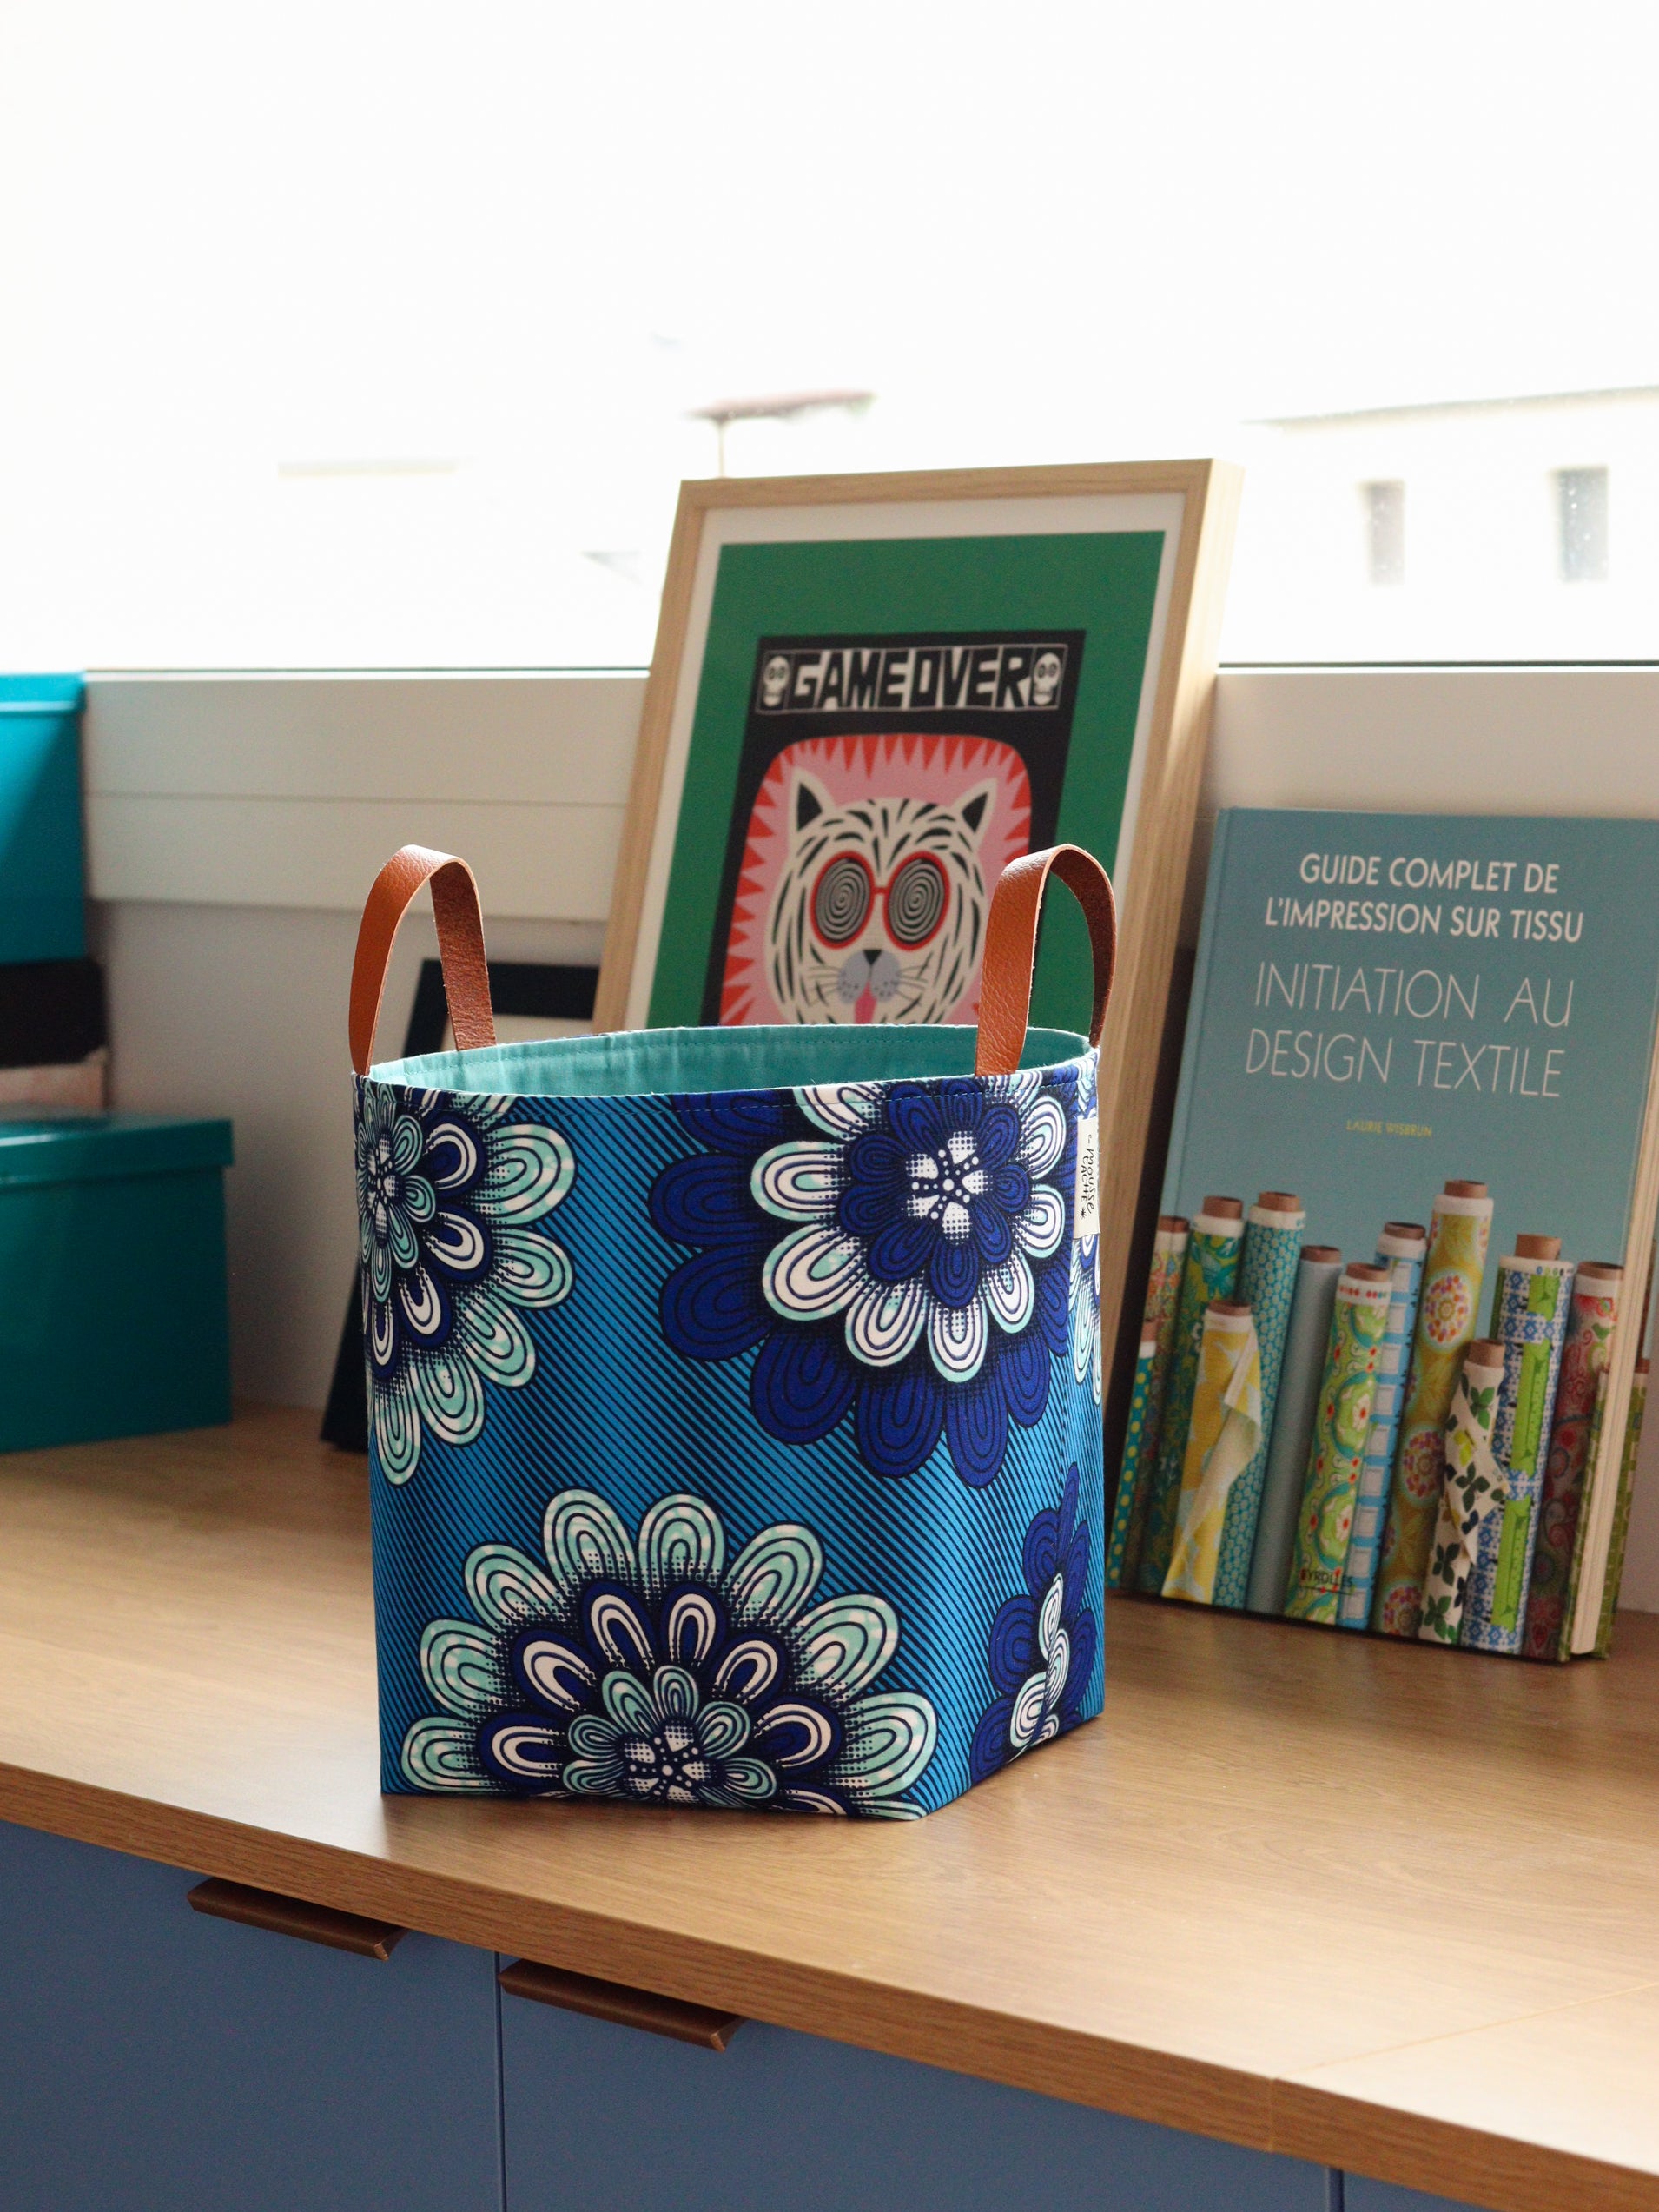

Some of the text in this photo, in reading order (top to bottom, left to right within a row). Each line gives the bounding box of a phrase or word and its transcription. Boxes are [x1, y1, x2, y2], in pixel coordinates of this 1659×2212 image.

[1299, 852, 1561, 894] GUIDE COMPLET DE
[1265, 897, 1584, 943] L'IMPRESSION SUR TISSU
[1255, 961, 1575, 1028] INITIATION AU
[1246, 1028, 1566, 1097] DESIGN TEXTILE
